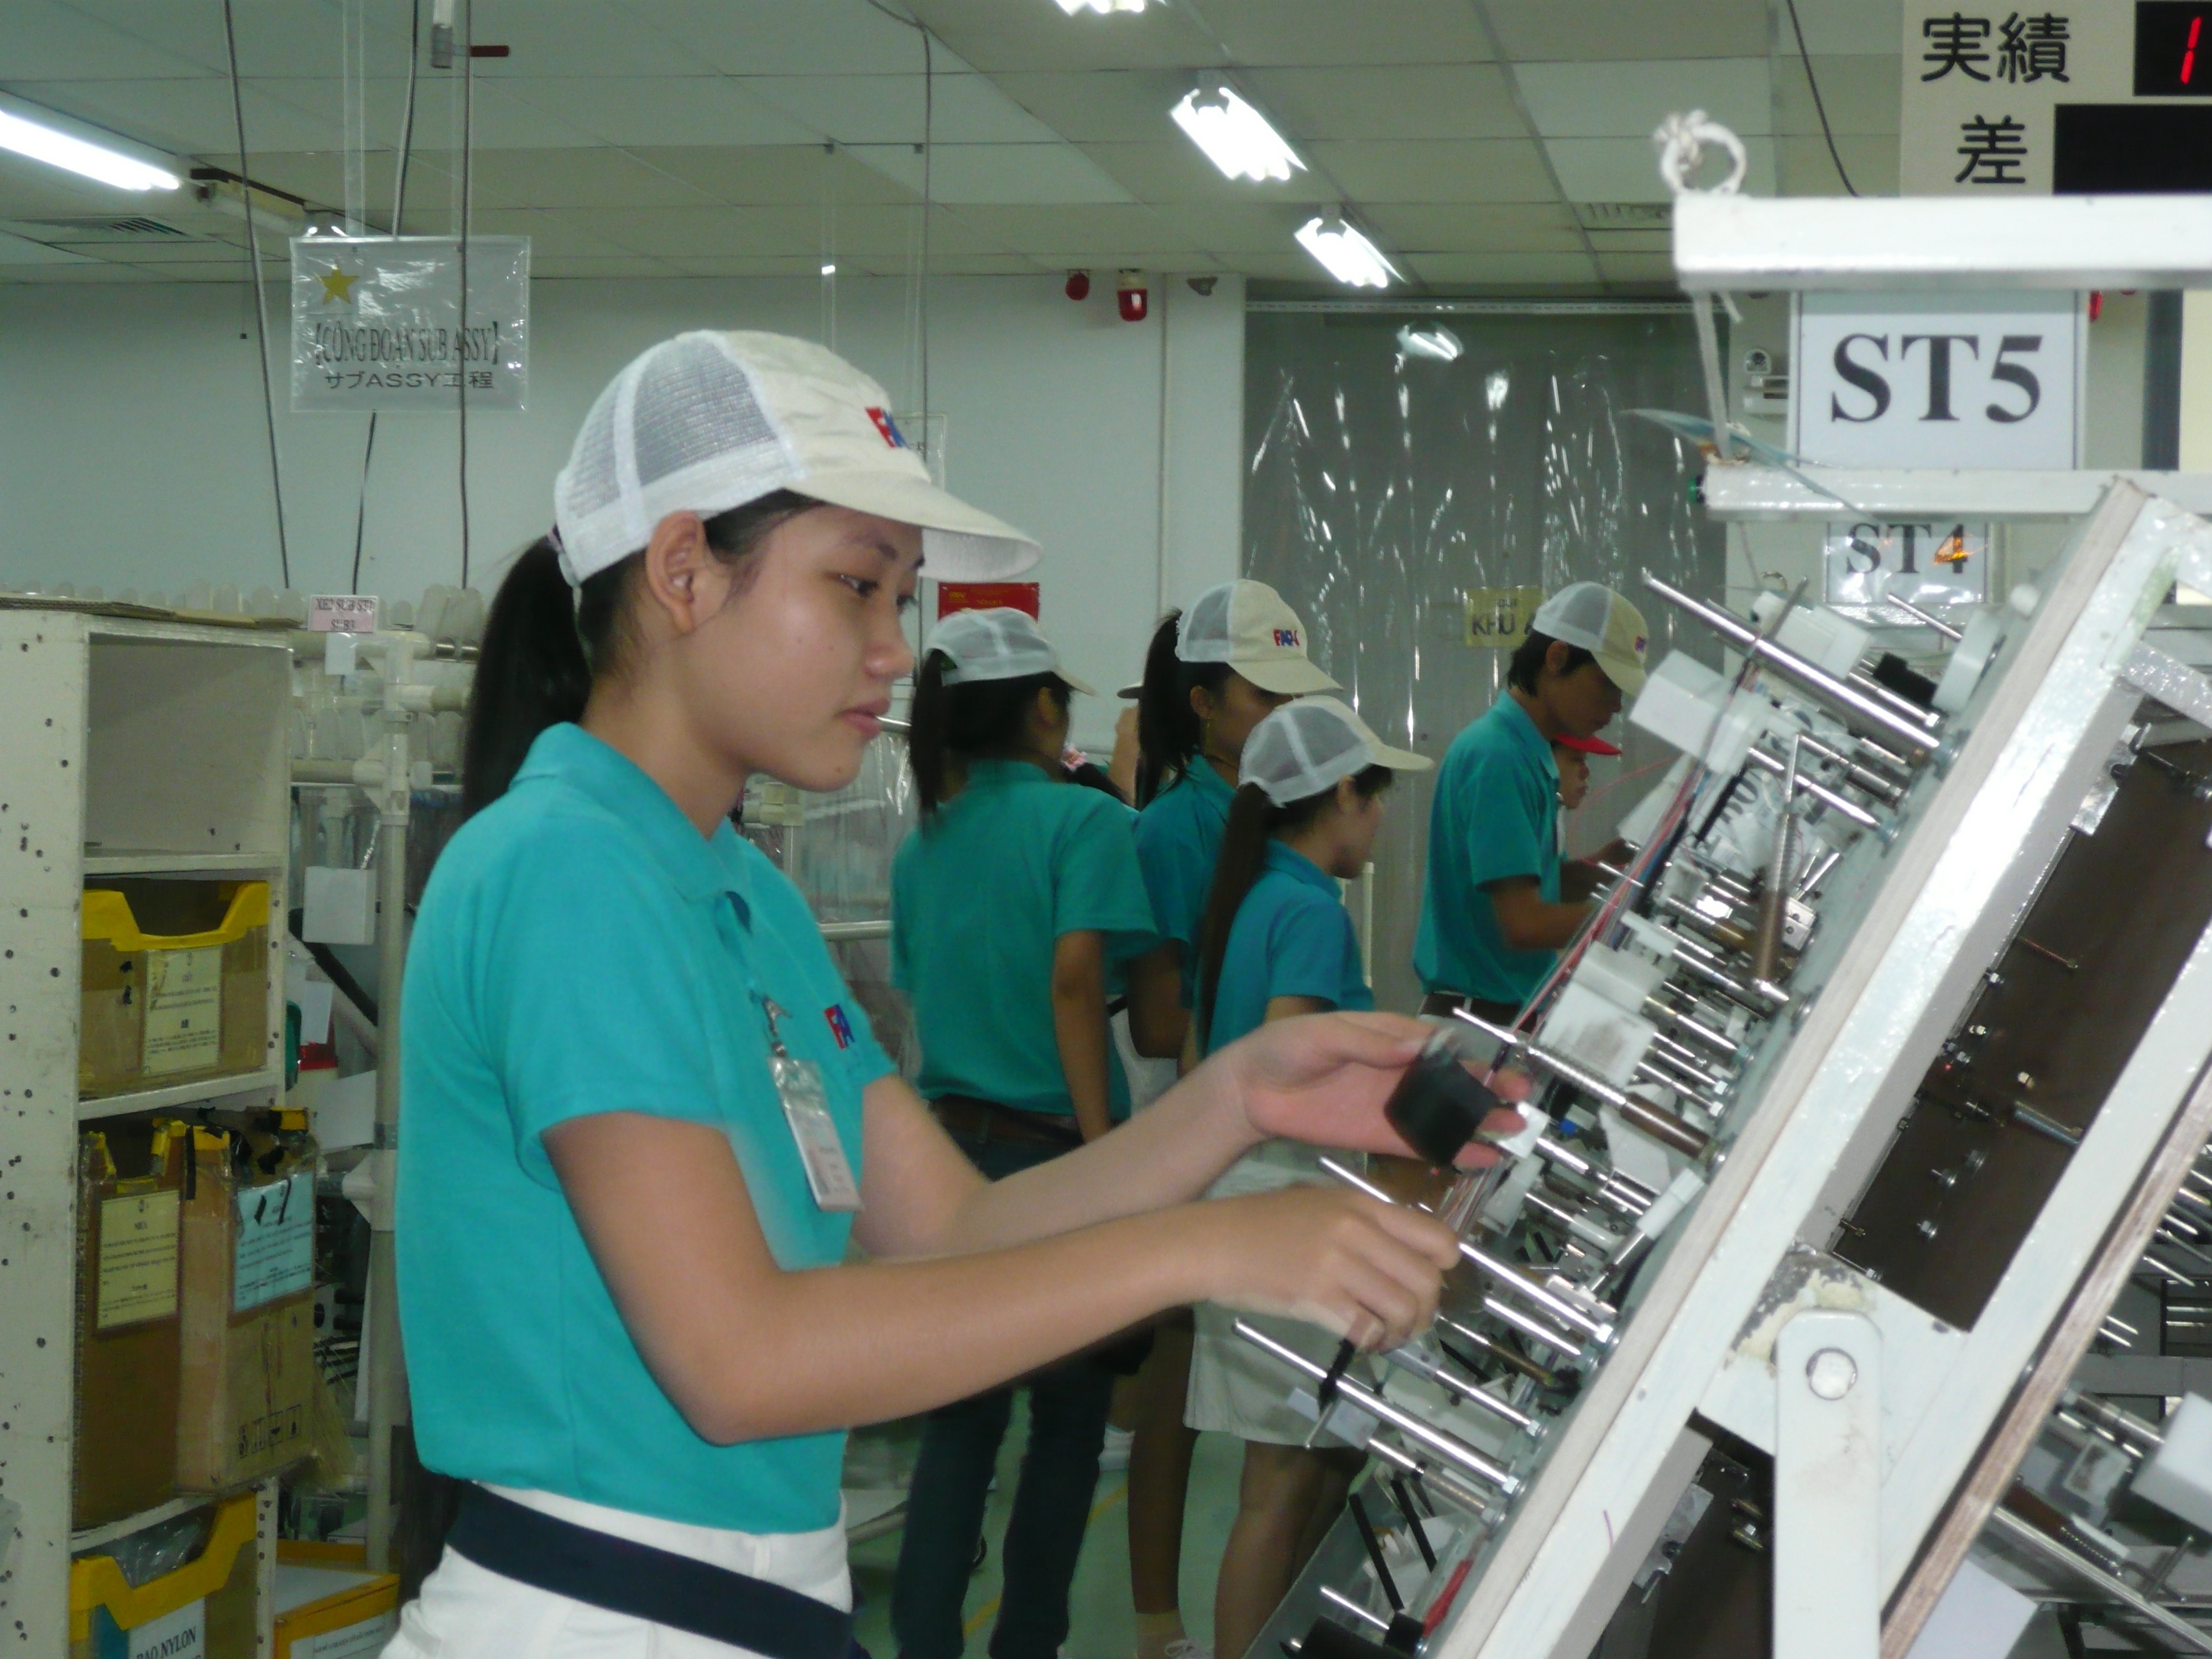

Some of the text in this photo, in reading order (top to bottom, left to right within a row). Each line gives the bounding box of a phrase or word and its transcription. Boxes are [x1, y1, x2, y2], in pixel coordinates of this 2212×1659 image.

[1921, 12, 2070, 83] 実績
[2180, 16, 2201, 85] 1
[1954, 114, 2027, 184] 差
[419, 328, 447, 361] SUB
[325, 371, 494, 389] サブASSY工程
[1831, 332, 2043, 424] ST5
[1846, 523, 1969, 574] ST4
[161, 1626, 196, 1659] NYLON
